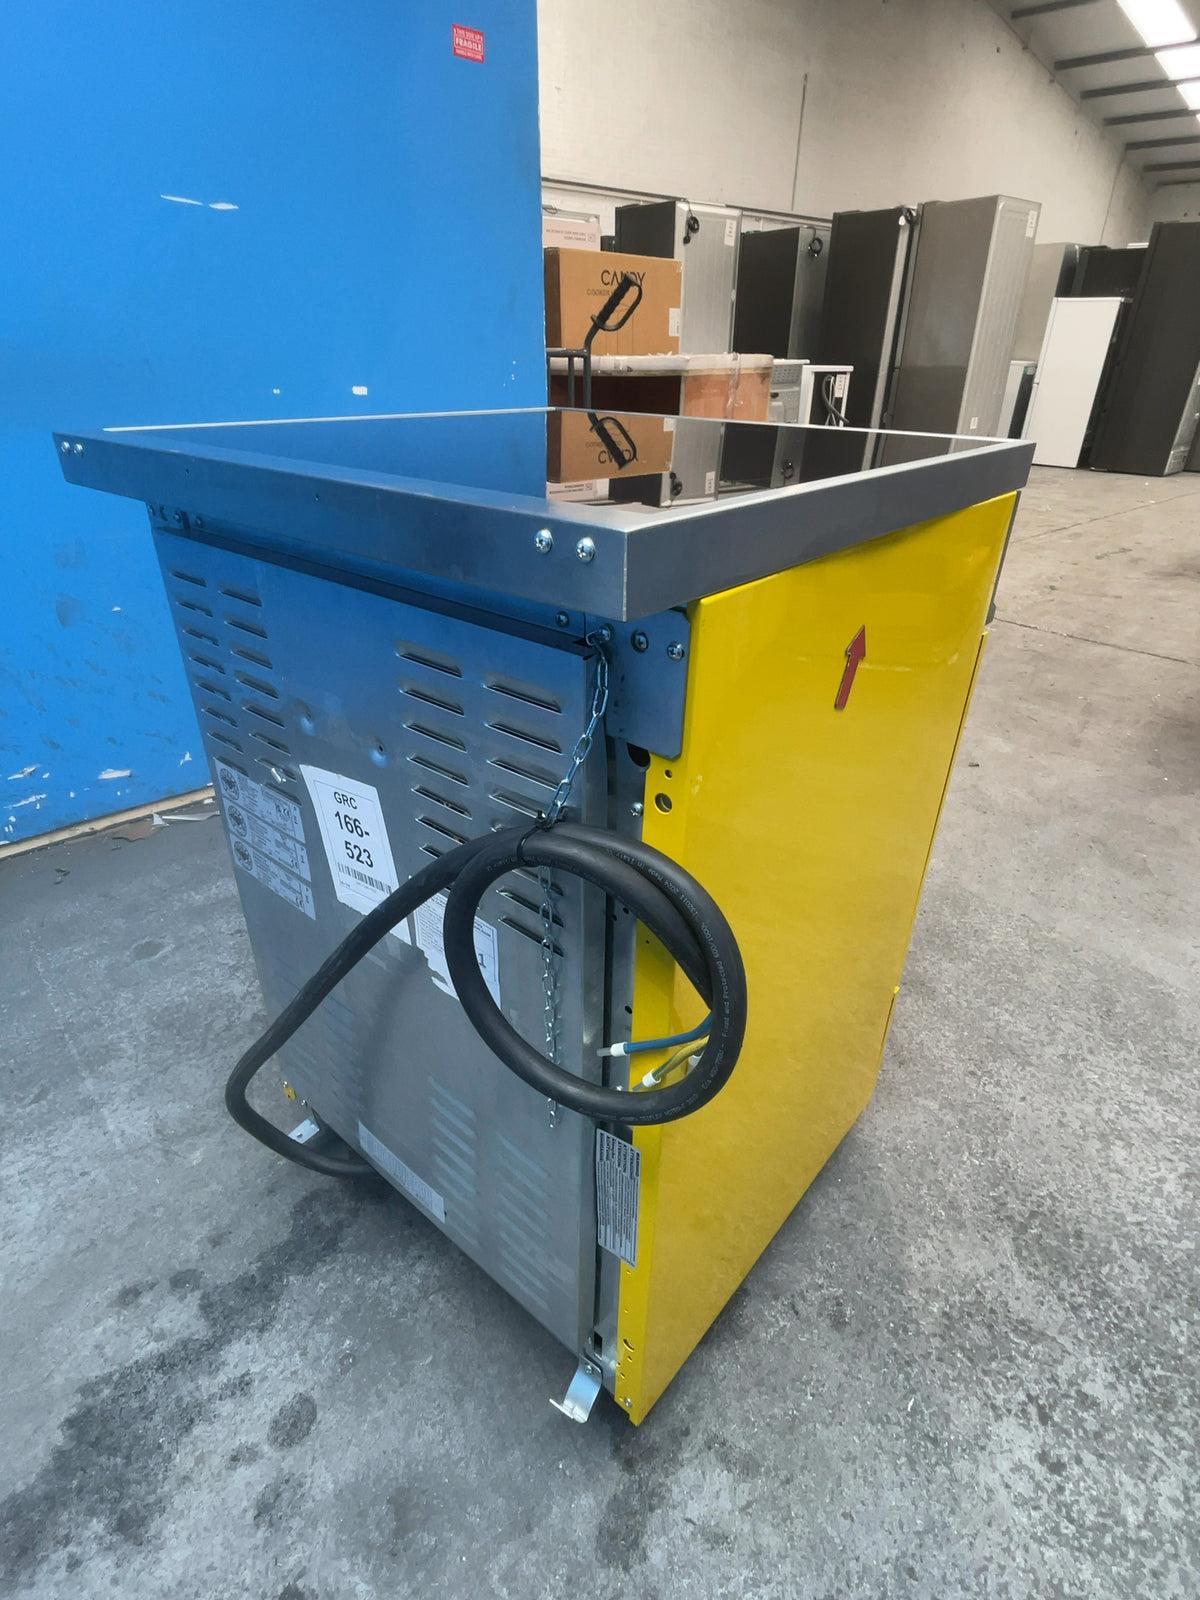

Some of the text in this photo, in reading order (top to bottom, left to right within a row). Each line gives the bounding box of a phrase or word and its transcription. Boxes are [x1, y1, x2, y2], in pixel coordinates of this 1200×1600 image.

[455, 37, 482, 52] FRAGILE
[333, 791, 357, 809] GRC
[335, 811, 370, 838] 166-
[345, 840, 373, 868] 523
